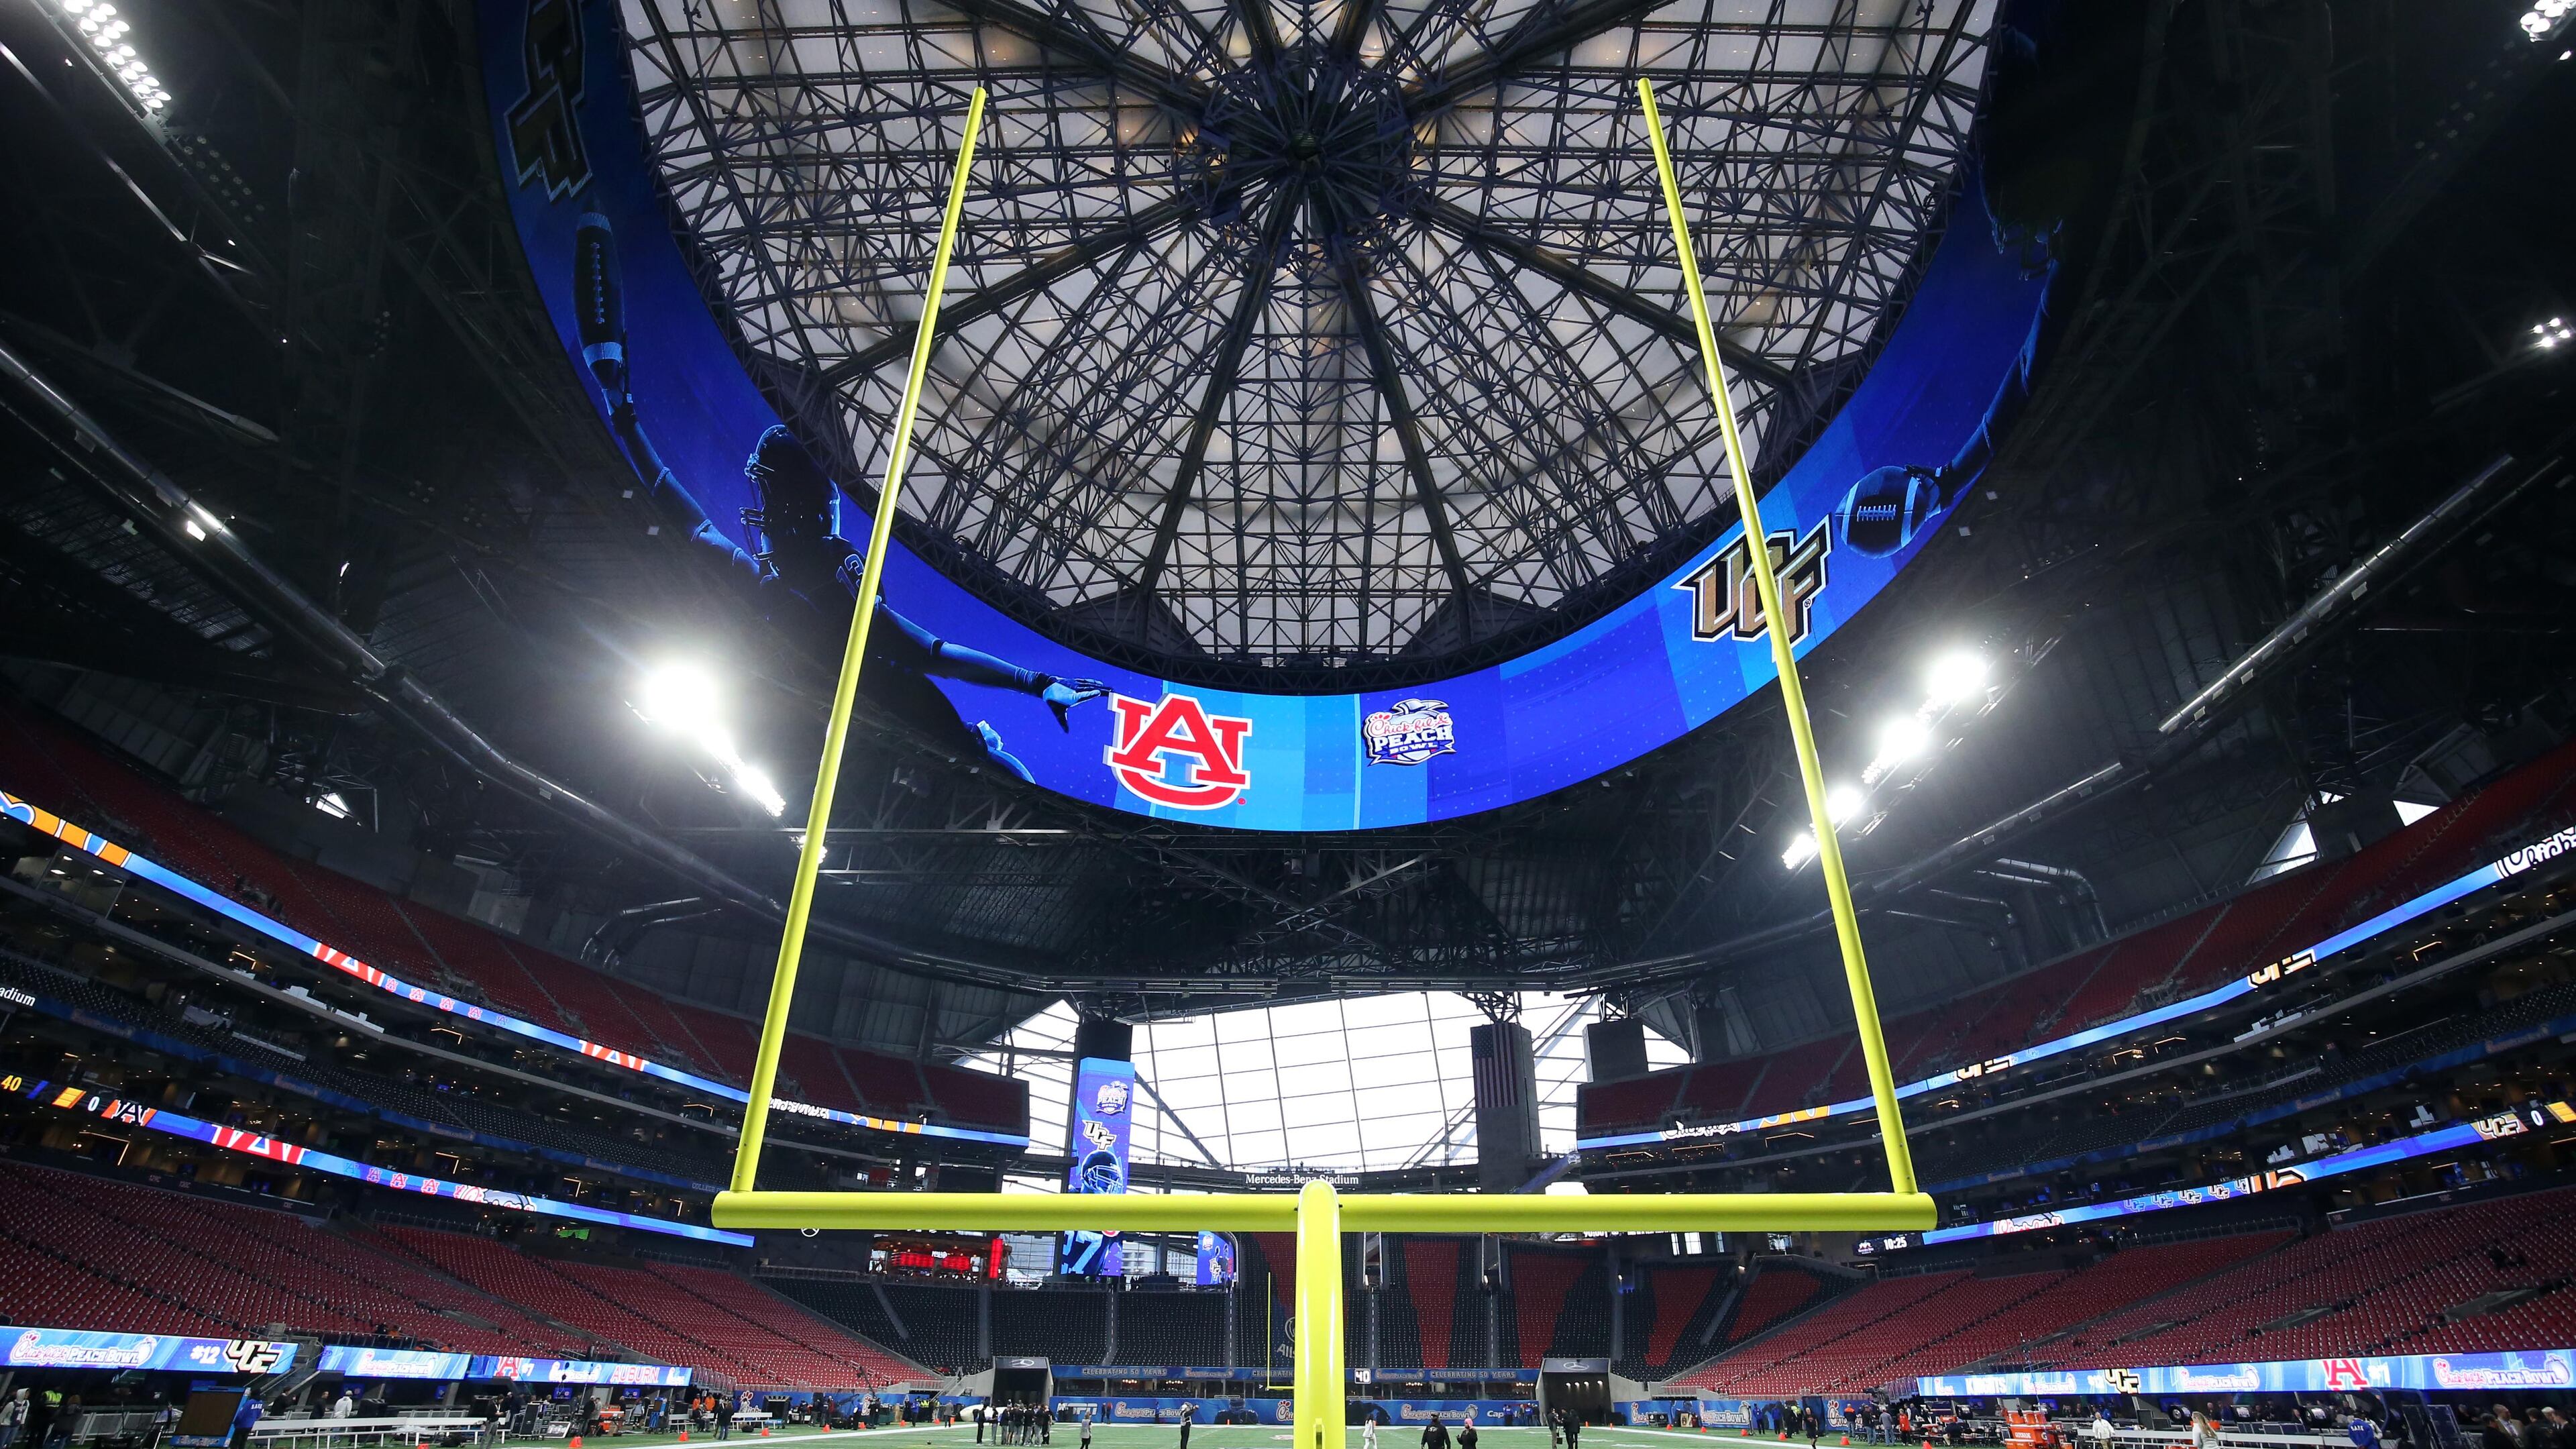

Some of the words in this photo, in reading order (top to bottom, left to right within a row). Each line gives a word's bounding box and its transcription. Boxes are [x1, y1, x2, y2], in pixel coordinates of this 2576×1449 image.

[1373, 724, 1454, 752] PEACH
[1389, 742, 1438, 755] BOWL
[1, 1075, 22, 1092] 40
[88, 1096, 100, 1112] 0
[2530, 1110, 2544, 1126] 0
[1082, 1120, 1117, 1150] UCF
[1884, 1236, 1907, 1250] 10:25
[68, 1347, 109, 1362] PEACH
[107, 1349, 139, 1363] BOWL
[191, 1345, 221, 1364] #12
[610, 1364, 659, 1384] AUBURN
[1355, 1371, 1371, 1383] 40
[2483, 1371, 2523, 1385] PEACH
[2521, 1370, 2561, 1384] BOWL
[1726, 1412, 1746, 1422] BOWL
